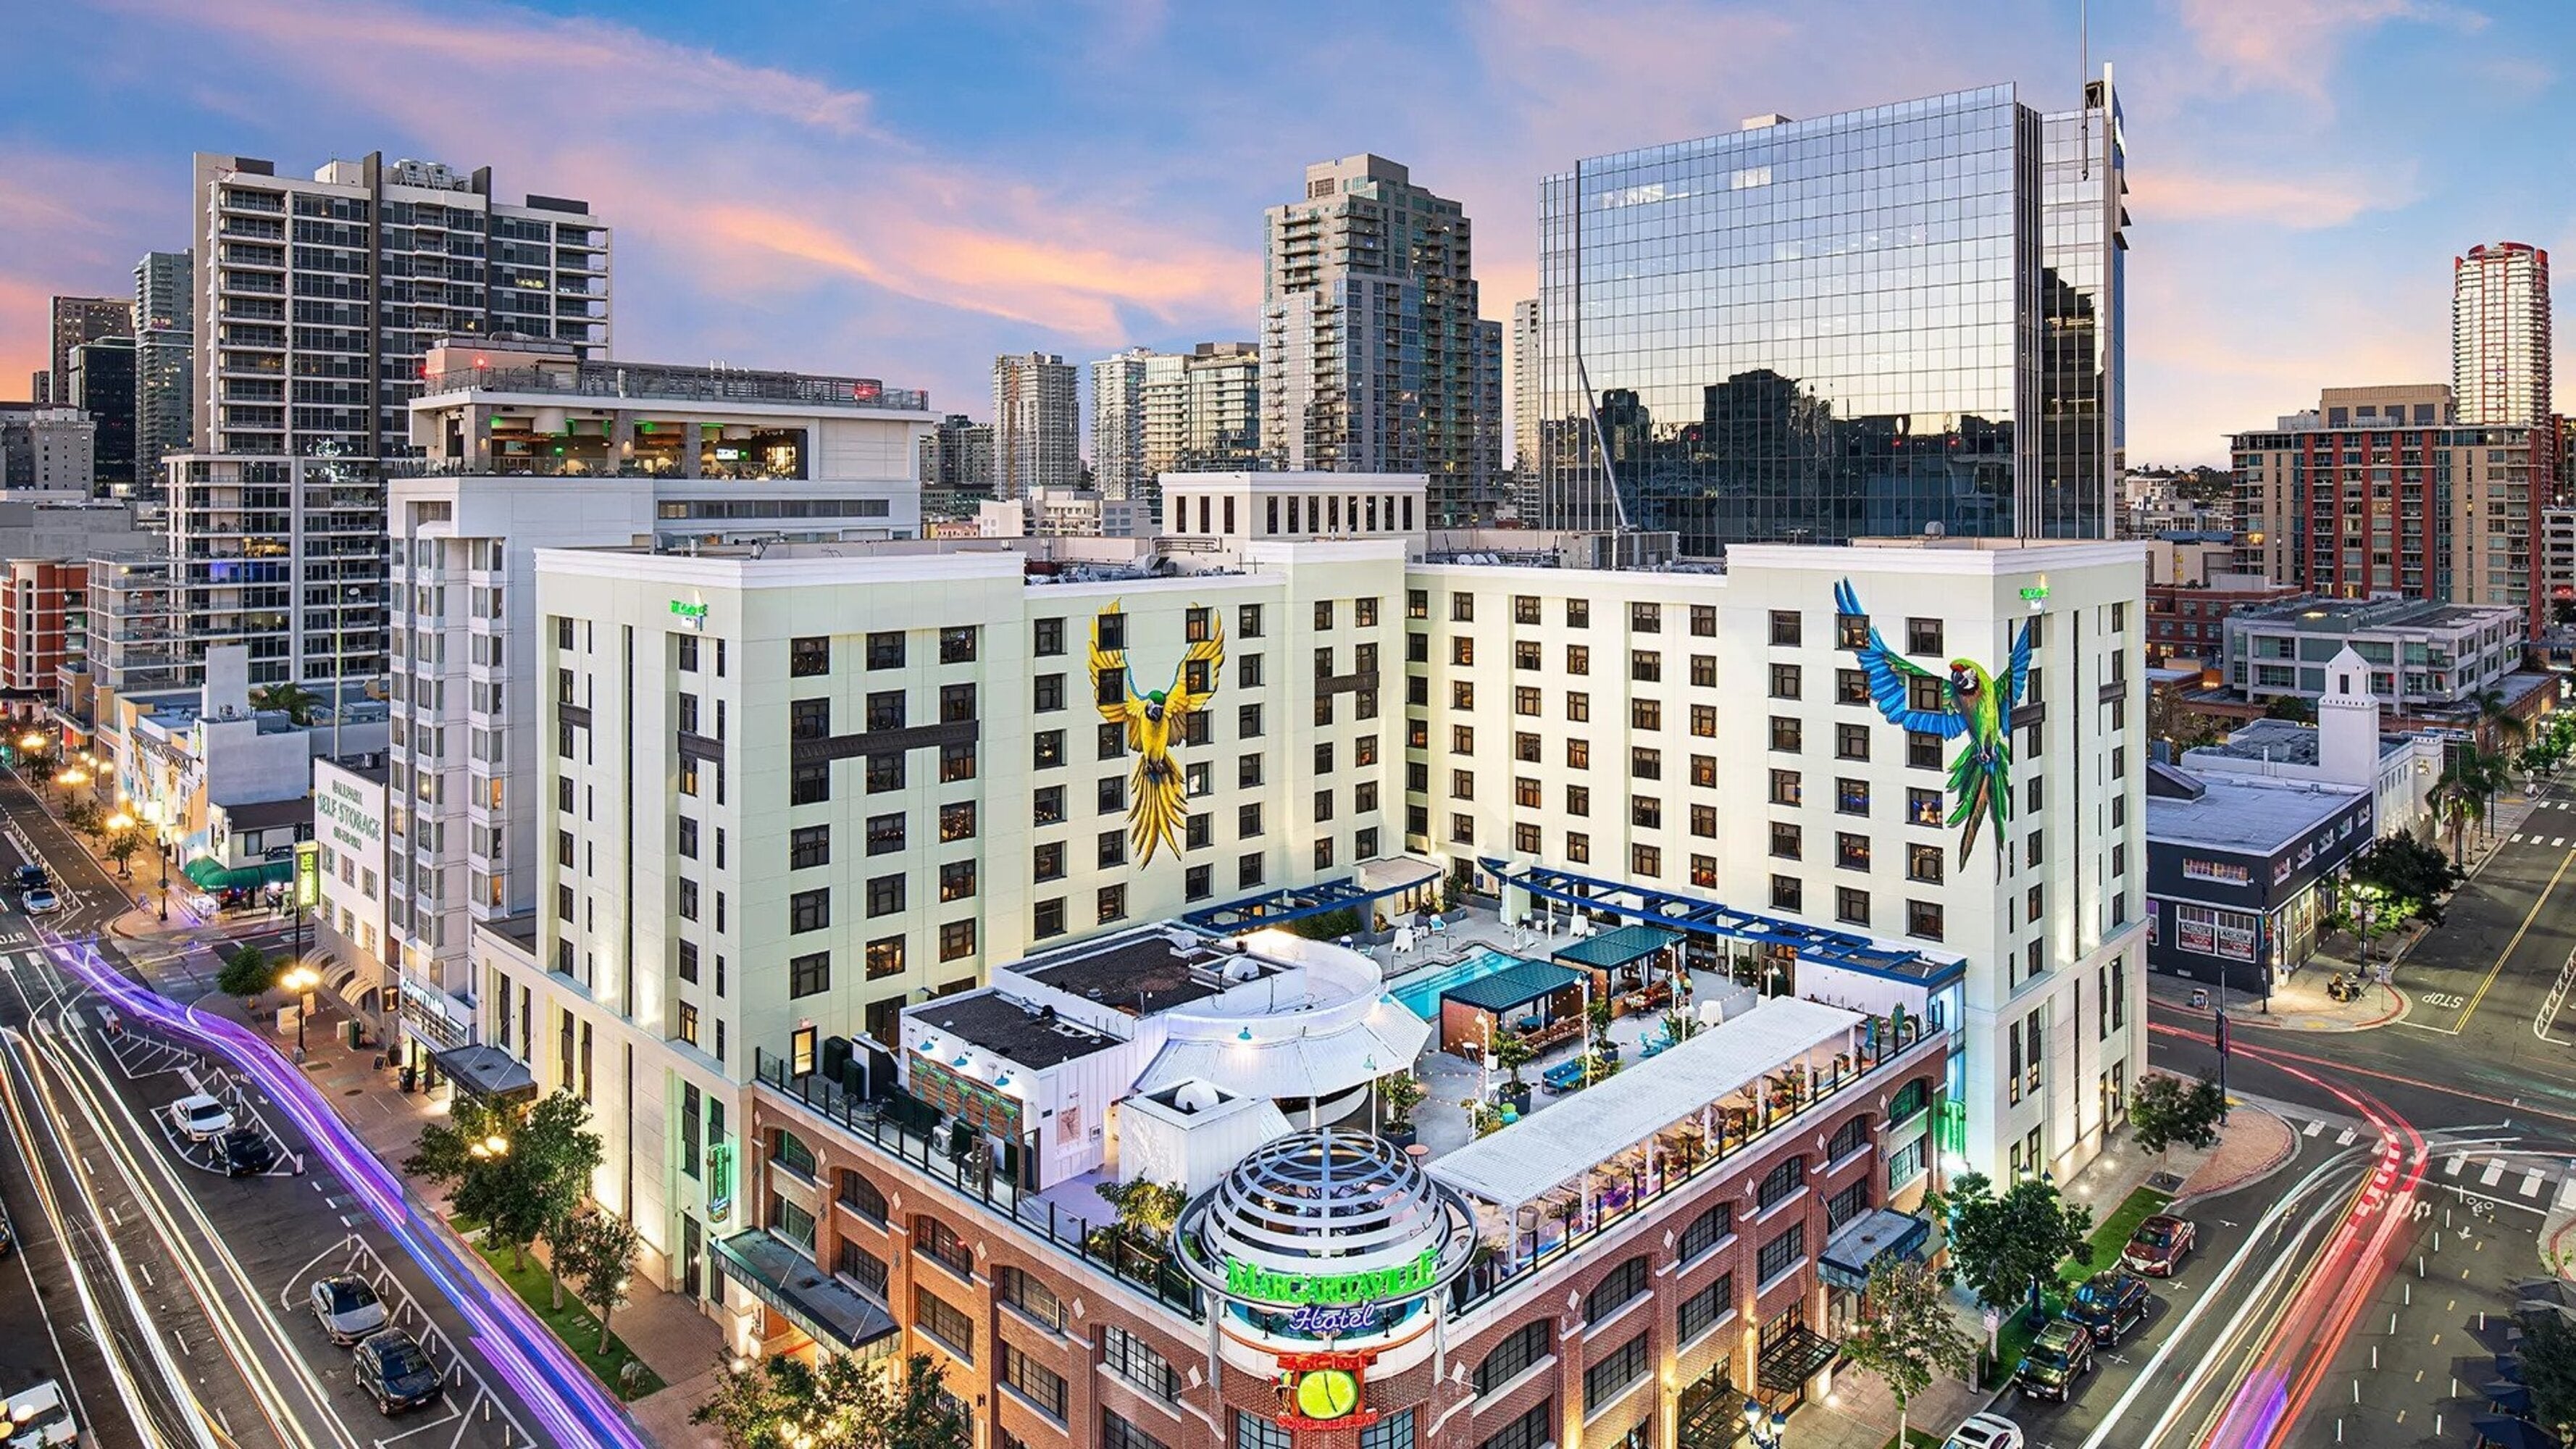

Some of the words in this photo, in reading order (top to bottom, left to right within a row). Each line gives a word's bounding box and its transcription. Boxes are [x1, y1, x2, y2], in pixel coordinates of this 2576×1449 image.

[317, 793, 338, 817] SELF
[338, 803, 381, 841] STORAGE
[2421, 992, 2464, 1009] STOP
[1226, 1248, 1438, 1303] MARGARITAVILLE
[1289, 1304, 1376, 1331] Hotel
[1277, 1415, 1352, 1431] SOMEWHERE
[1355, 1413, 1377, 1427] BAR
